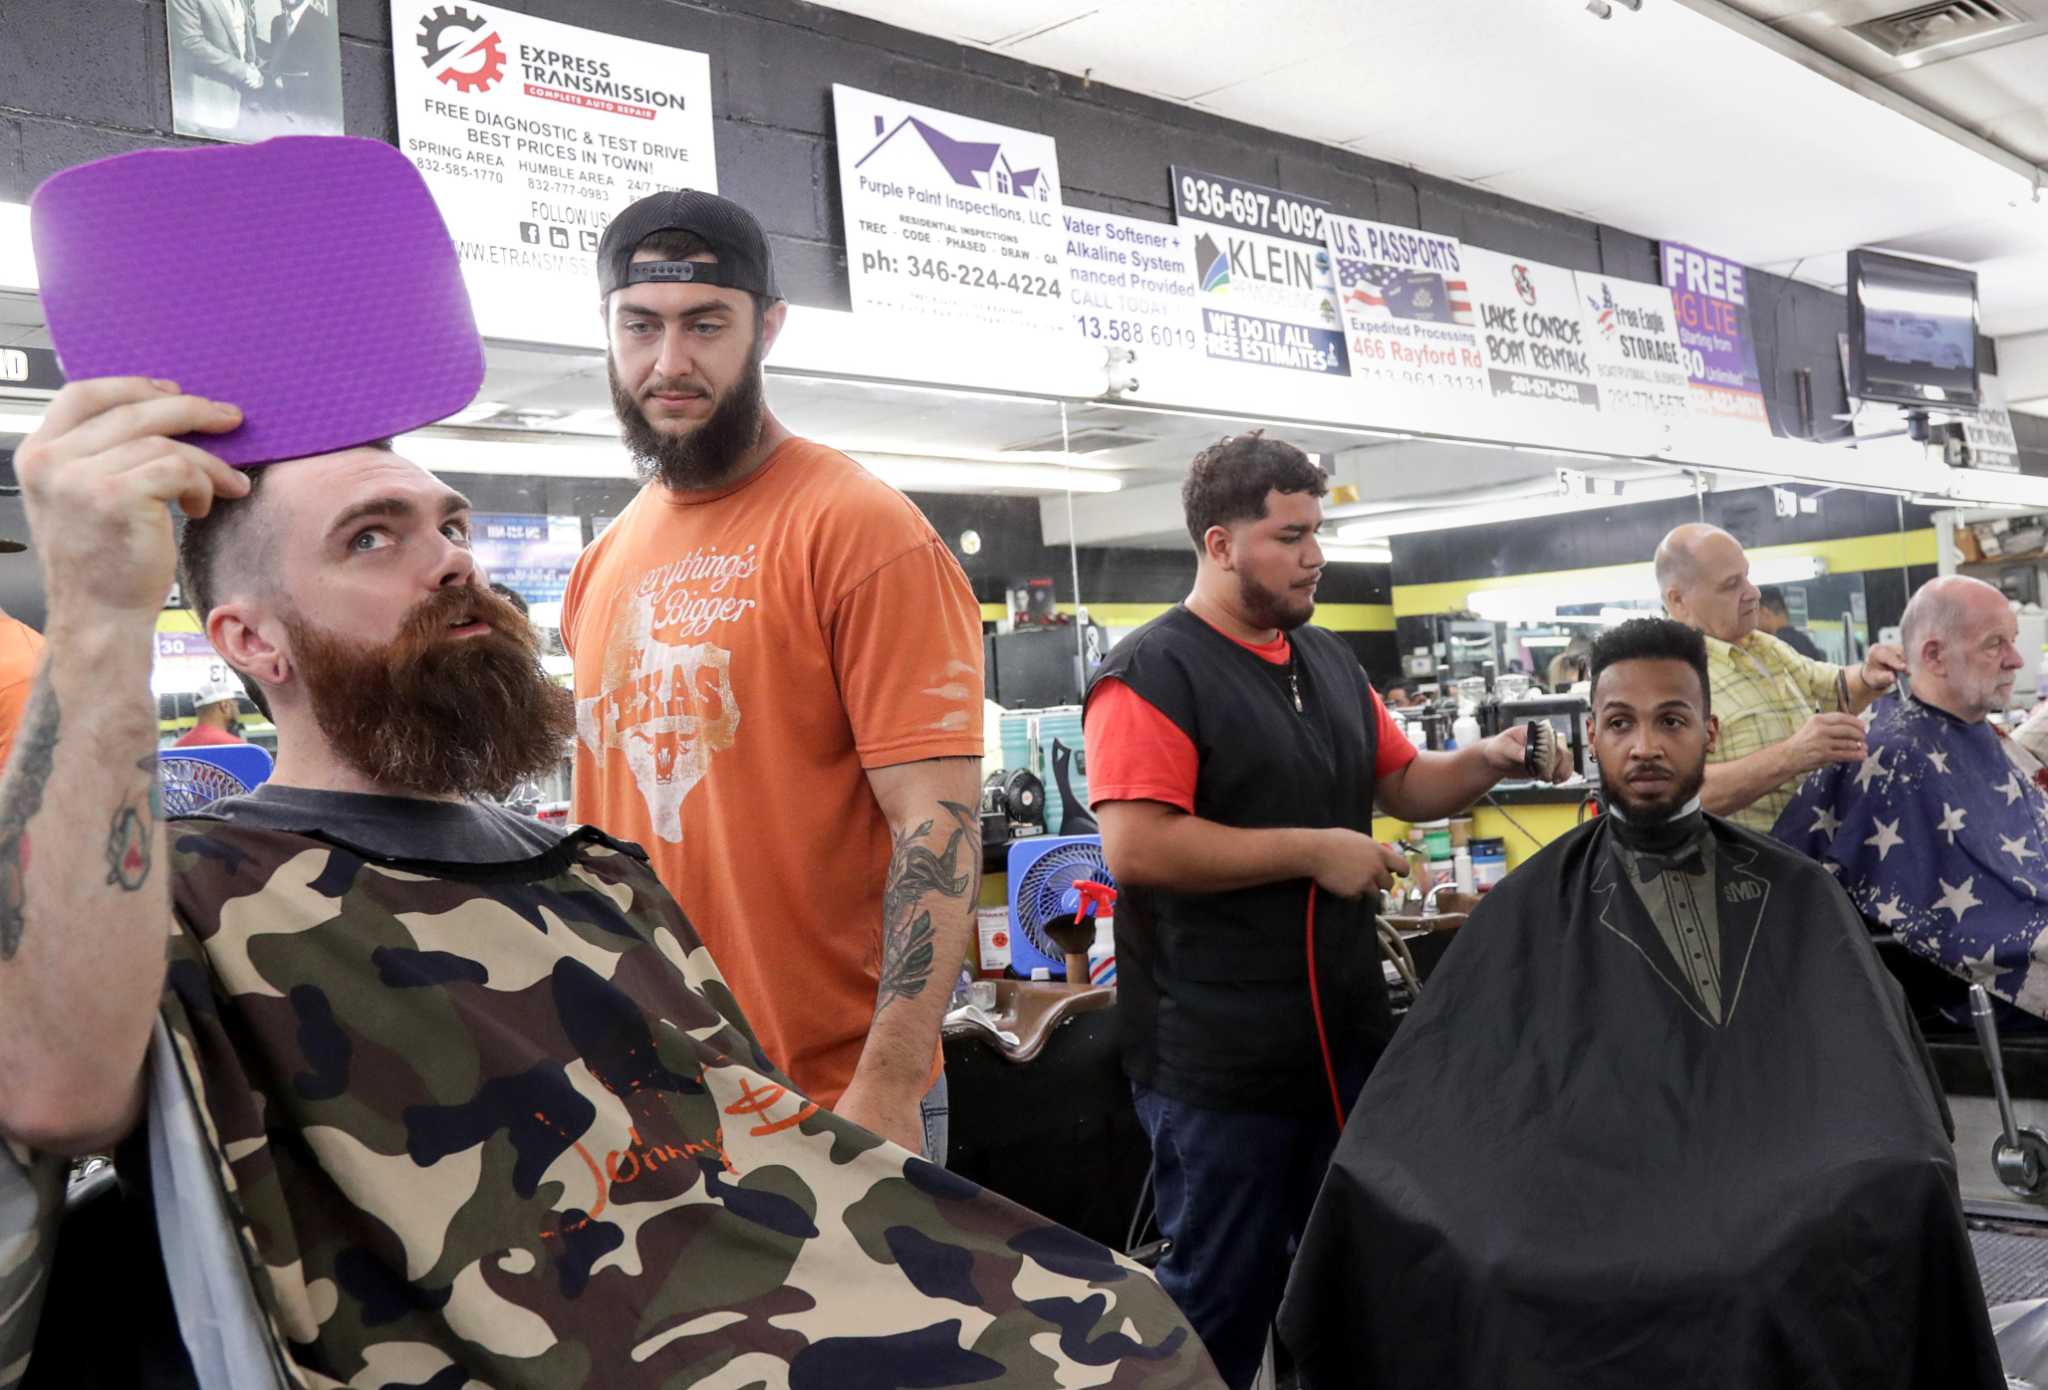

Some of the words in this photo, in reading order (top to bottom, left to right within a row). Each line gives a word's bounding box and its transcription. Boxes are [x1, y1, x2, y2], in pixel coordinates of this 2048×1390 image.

[520, 45, 610, 78] EXPRESS
[521, 64, 685, 111] TRANSMISSION
[529, 86, 583, 106] COMPLETE
[586, 97, 614, 112] AUTO
[617, 103, 654, 118] REPAIR
[425, 99, 469, 121] FREE
[475, 110, 577, 143] DIAGNOSTIC
[584, 131, 594, 145] &
[598, 134, 636, 154] TEST
[643, 143, 689, 162] DRIVE
[408, 139, 462, 160] SPRING
[466, 151, 505, 168] AREA
[467, 129, 512, 150] BEST
[516, 138, 577, 162] PRICES
[581, 152, 597, 166] IN
[602, 154, 654, 175] TOWN!
[416, 157, 503, 184] 832-585-1770
[519, 160, 574, 180] HUMBLE
[578, 170, 615, 187] AREA
[627, 179, 650, 192] 24/7
[527, 178, 609, 202] 832-777-0983
[860, 175, 903, 198] Purple
[946, 193, 1025, 223] Inspections,
[1030, 209, 1052, 227] LLC
[532, 201, 586, 225] FOLLOW
[899, 214, 958, 233] RESIDENTIAL
[960, 226, 1019, 244] INSPECTIONS
[859, 218, 887, 234] TREC
[903, 229, 931, 243] CODE
[946, 237, 987, 253] PHASED
[1001, 246, 1030, 260] DRAW
[1044, 254, 1058, 264] QA
[1105, 223, 1167, 248] Softener
[1330, 221, 1366, 257] U.S.
[1367, 228, 1460, 272] PASSPORTS
[1066, 240, 1126, 264] Alkaline
[1131, 251, 1185, 273] System
[1228, 237, 1313, 290] KLEIN
[862, 249, 898, 273] ph:
[907, 255, 1062, 299] 346-224-4224
[1070, 268, 1126, 287] nanced
[1130, 274, 1195, 297] Provided
[1666, 246, 1745, 306] FREE
[1071, 288, 1113, 309] CALL
[1074, 314, 1196, 349] 13.588.6019
[1208, 311, 1236, 337] WE
[1238, 317, 1263, 340] DO
[1265, 322, 1282, 343] IT
[1284, 325, 1313, 348] ALL
[1351, 317, 1410, 336] Expedited
[1414, 324, 1476, 346] Processing
[1480, 304, 1517, 334] LAKE
[1523, 312, 1583, 346] CONROE
[1614, 304, 1639, 328] Free
[1702, 297, 1738, 337] LTE
[1241, 340, 1328, 371] ESTIMATES
[1353, 336, 1386, 360] 466
[1390, 341, 1457, 368] Rayford
[1461, 348, 1483, 368] Rd
[1486, 335, 1528, 365] BOAT
[1530, 342, 1590, 377] RENTALS
[1620, 335, 1679, 364] STORAGE
[655, 590, 756, 637] Bigger
